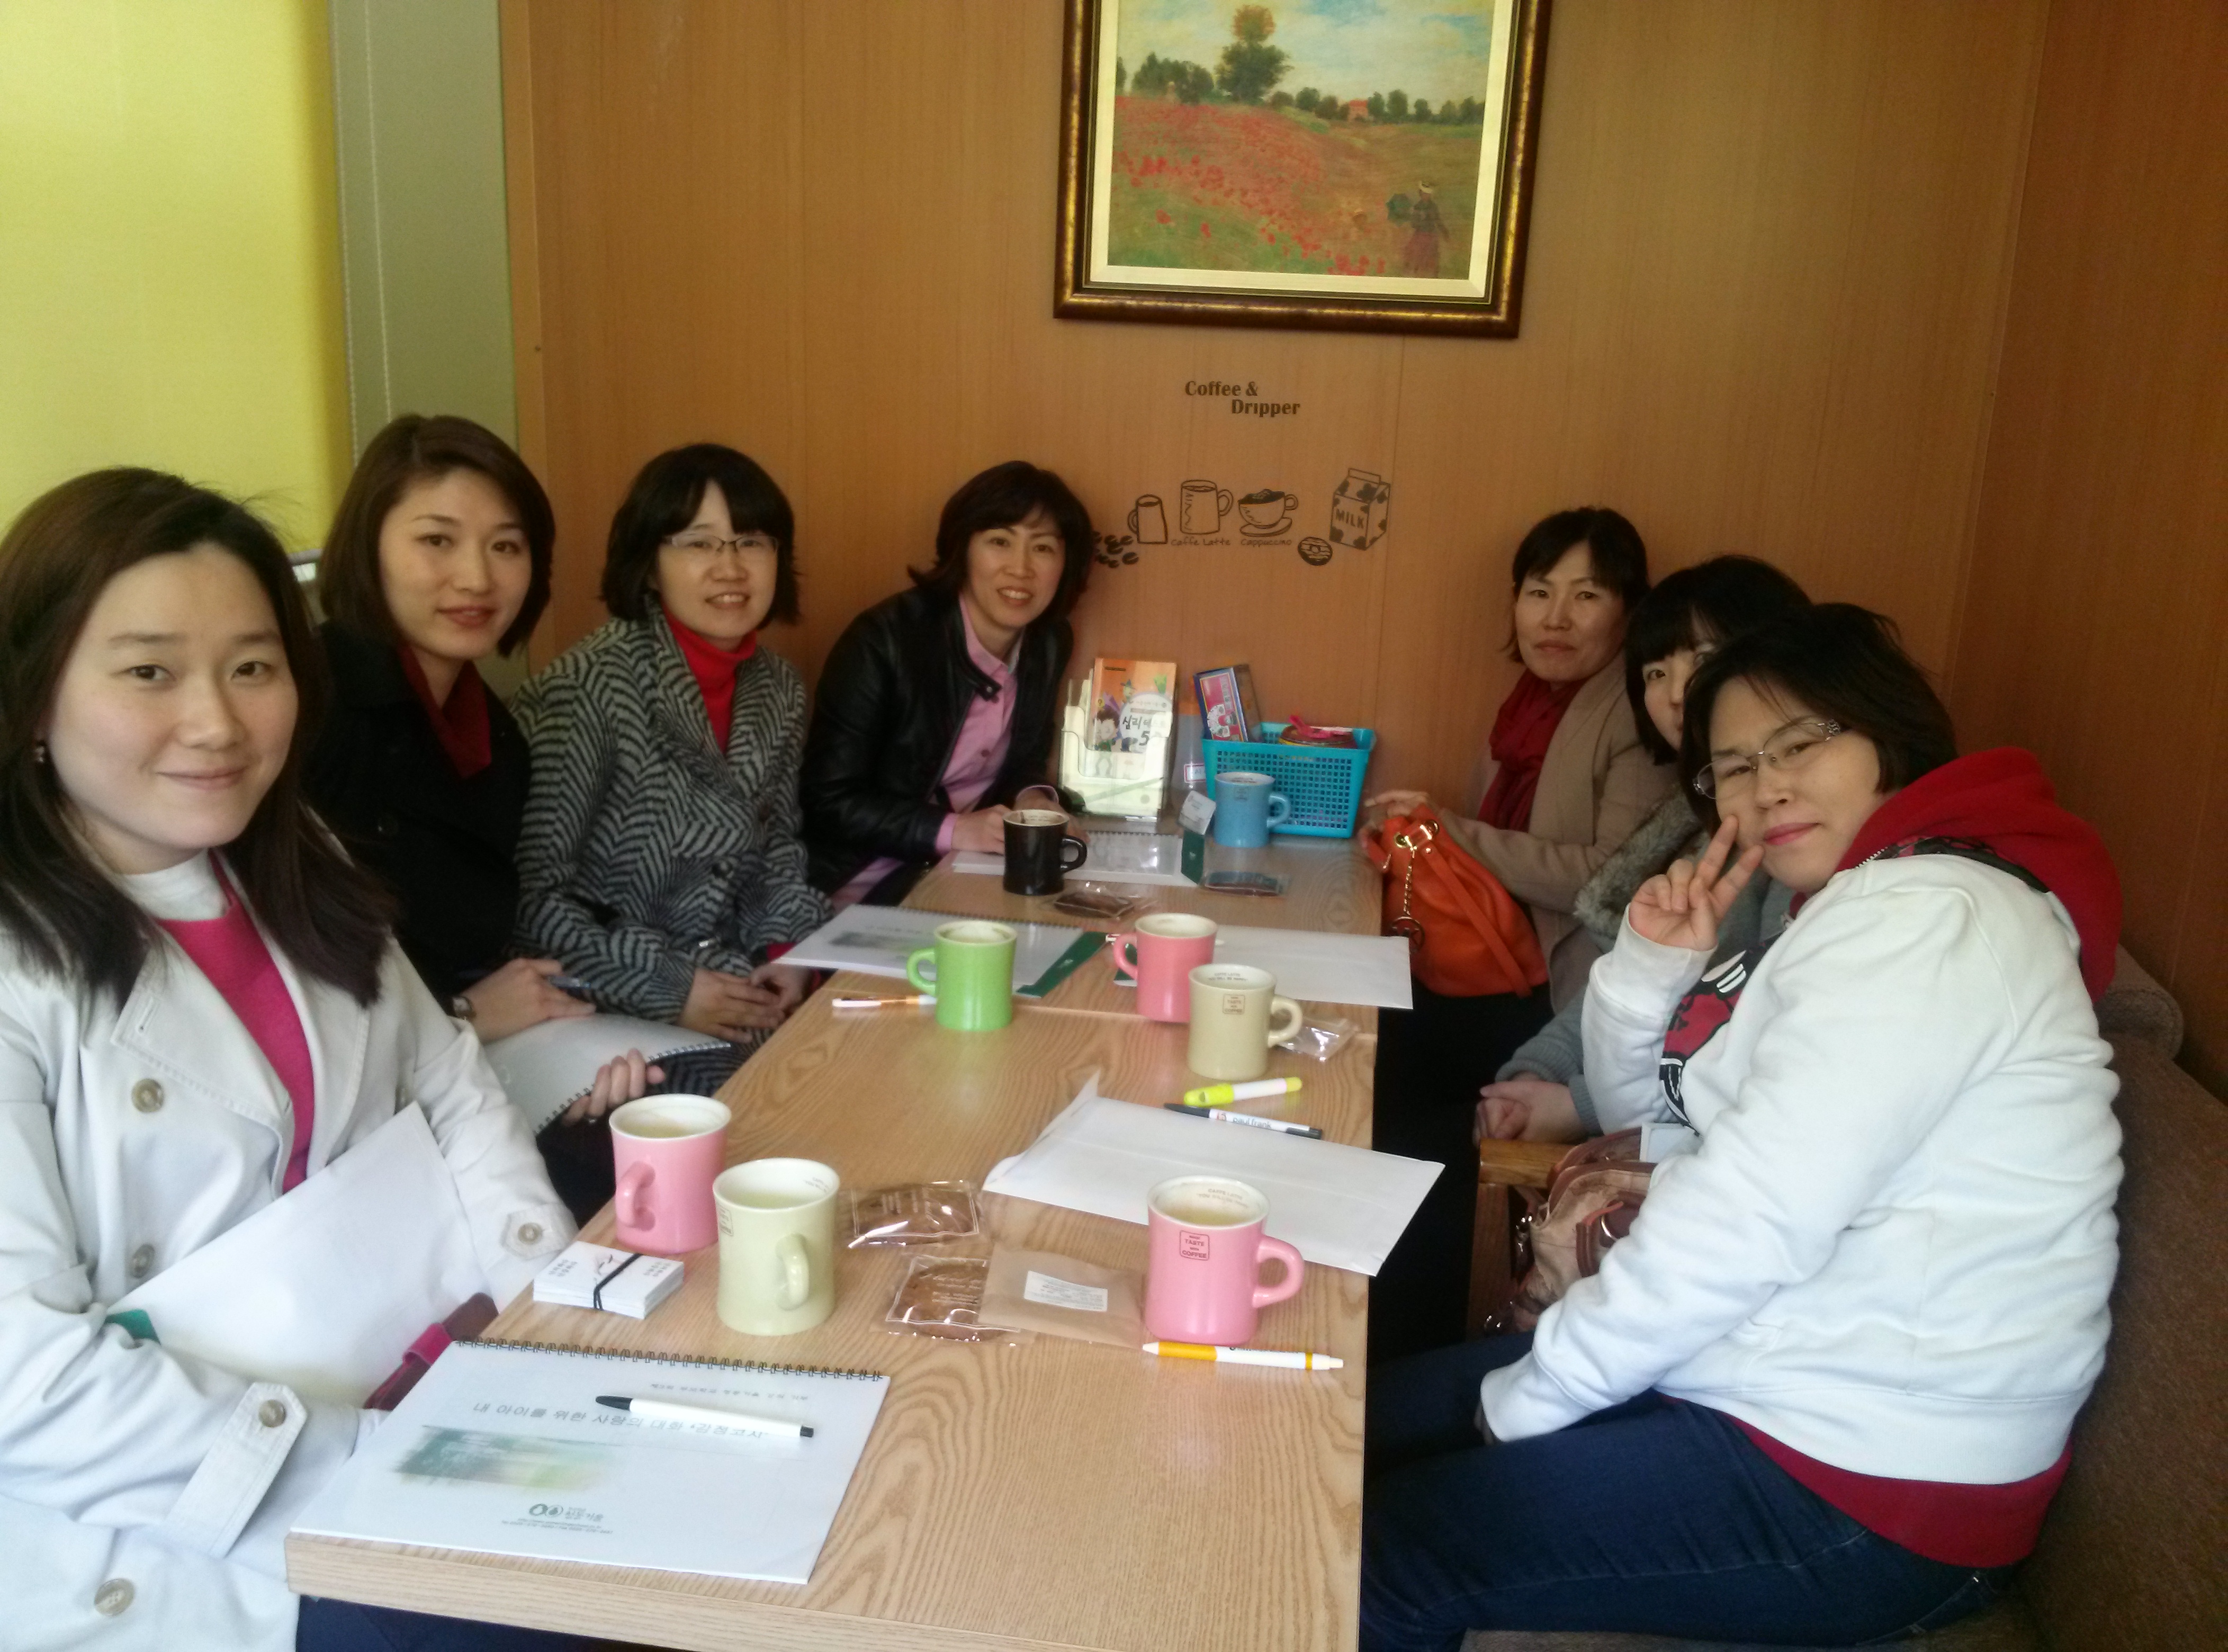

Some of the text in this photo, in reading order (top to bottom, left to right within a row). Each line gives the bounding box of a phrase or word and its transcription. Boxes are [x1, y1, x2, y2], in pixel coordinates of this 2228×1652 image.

[1185, 381, 1258, 396] Coffee &
[1232, 399, 1300, 417] Dripper
[1336, 508, 1364, 529] MILK
[1233, 1116, 1271, 1128] paul frank
[473, 1403, 490, 1413] 내
[496, 1405, 547, 1418] 아이를
[553, 1411, 586, 1421] 위한
[592, 1414, 644, 1427] 사랑의
[650, 1419, 684, 1430] 대화
